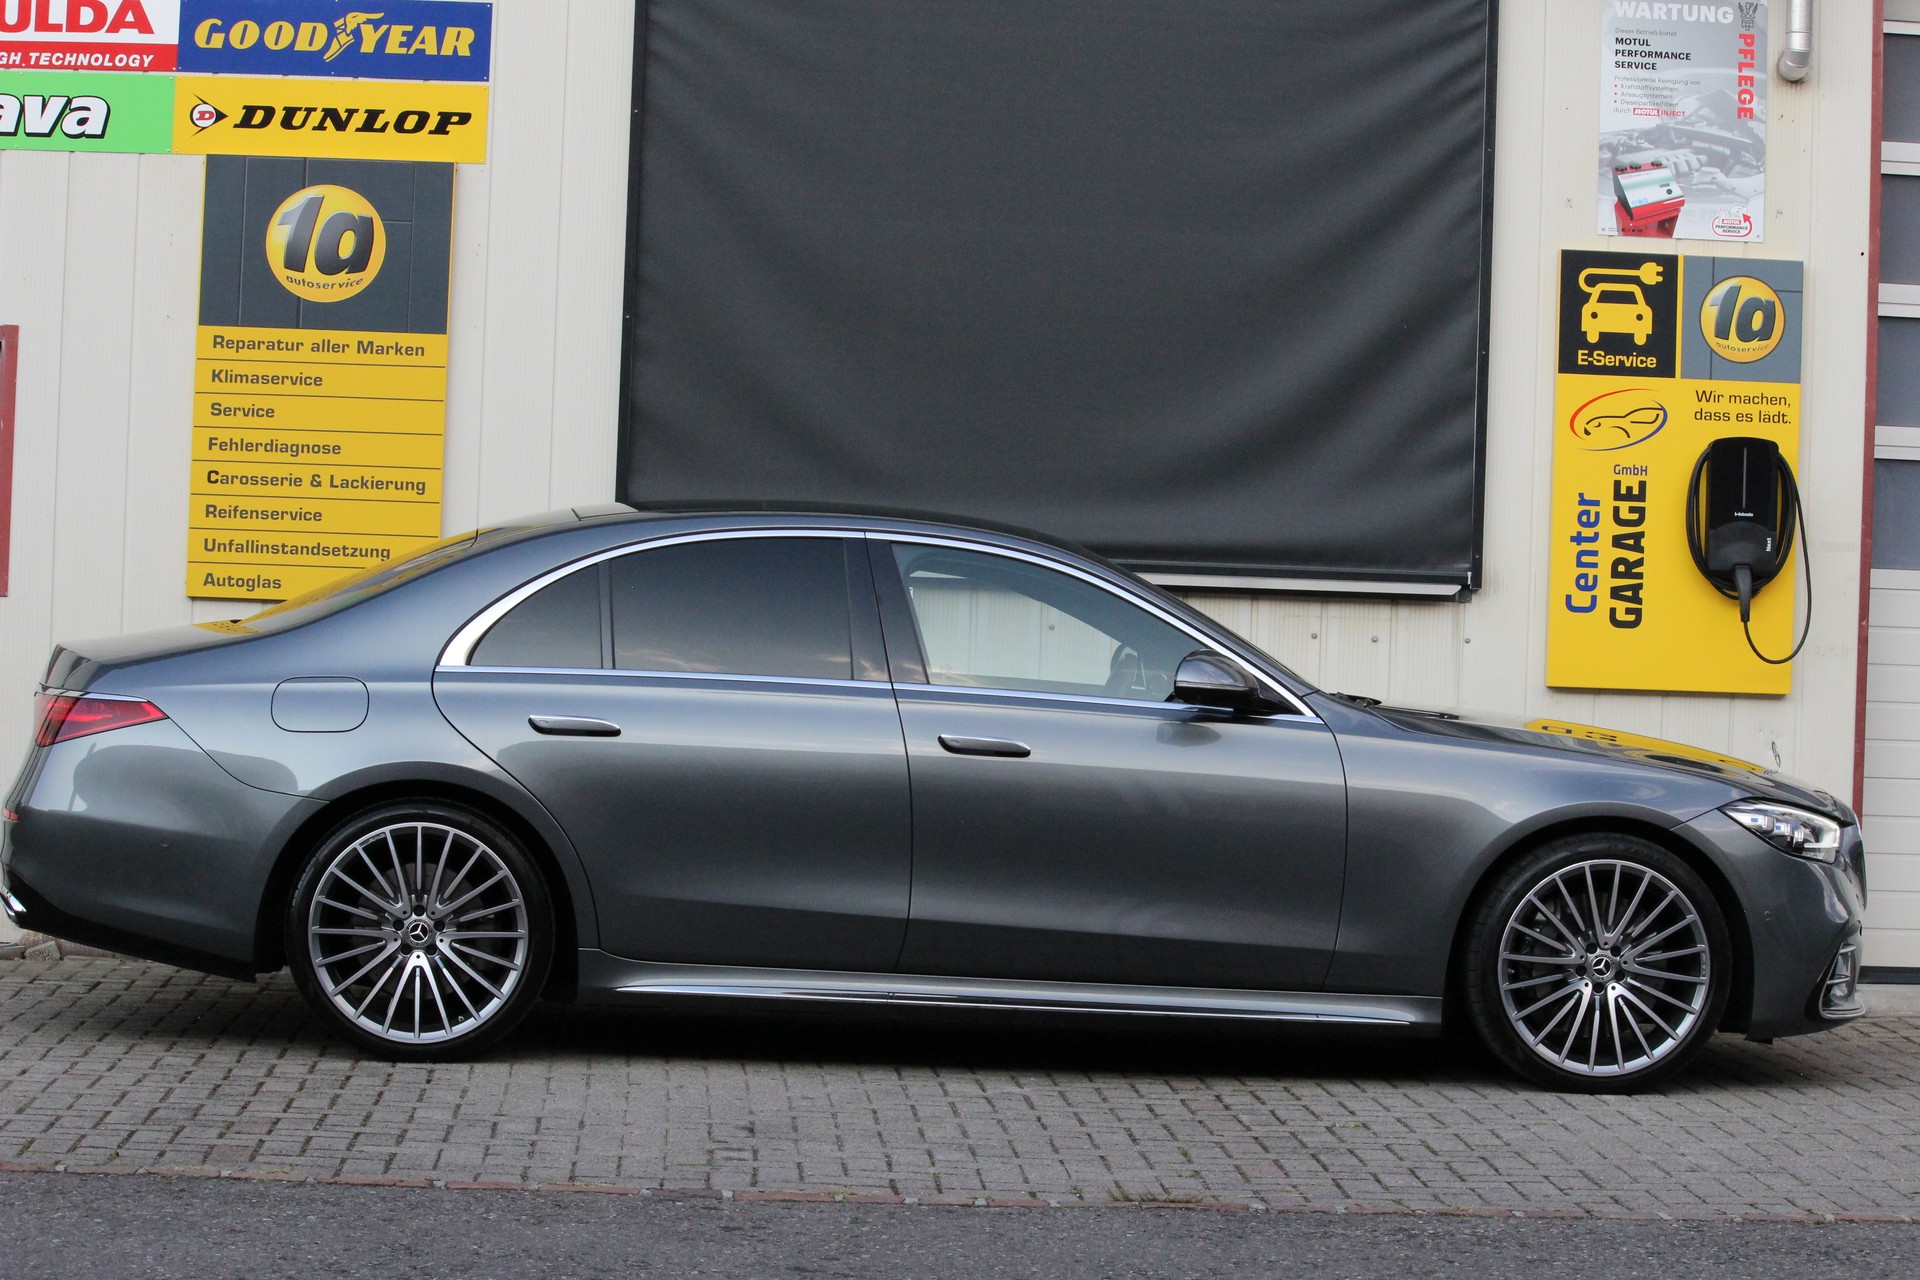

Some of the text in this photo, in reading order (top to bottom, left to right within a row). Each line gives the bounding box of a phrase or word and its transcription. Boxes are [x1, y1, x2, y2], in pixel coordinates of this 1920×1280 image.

[1615, 0, 1734, 25] WARTUNG
[1615, 27, 1634, 35] Dieser
[1635, 28, 1658, 36] Betrieb
[1615, 37, 1651, 47] MOTUL
[29, 52, 155, 67] TECHNOLOGY
[1615, 49, 1691, 60] PERFORMANCE
[1614, 60, 1657, 70] SERVICE
[1614, 75, 1657, 83] Professionelle
[1657, 78, 1688, 86] Reinigung
[1737, 33, 1755, 120] PFLEGE
[233, 104, 472, 136] DUNLOP
[1634, 108, 1659, 116] MOTUL
[277, 194, 375, 276] 1a
[286, 275, 363, 290] autoservice
[1709, 284, 1776, 343] 1a
[213, 335, 425, 357] Reparatur aller Marken
[1716, 342, 1769, 353] autoservice
[1577, 349, 1657, 368] E-Service
[211, 369, 323, 387] Klimaservice
[1695, 389, 1791, 408] Wir machen,
[210, 402, 275, 418] Service
[1694, 407, 1792, 424] dass es lädt.
[208, 437, 342, 457] Fehlerdiagnose
[1613, 464, 1648, 476] GmbH
[206, 470, 426, 495] Carosserie & Lackierung
[205, 504, 323, 522] Reifenservice
[203, 537, 391, 561] Unfallinstandsetzung
[1565, 492, 1601, 614] Center
[1609, 480, 1647, 629] GARAGE
[203, 573, 282, 592] Autoglas
